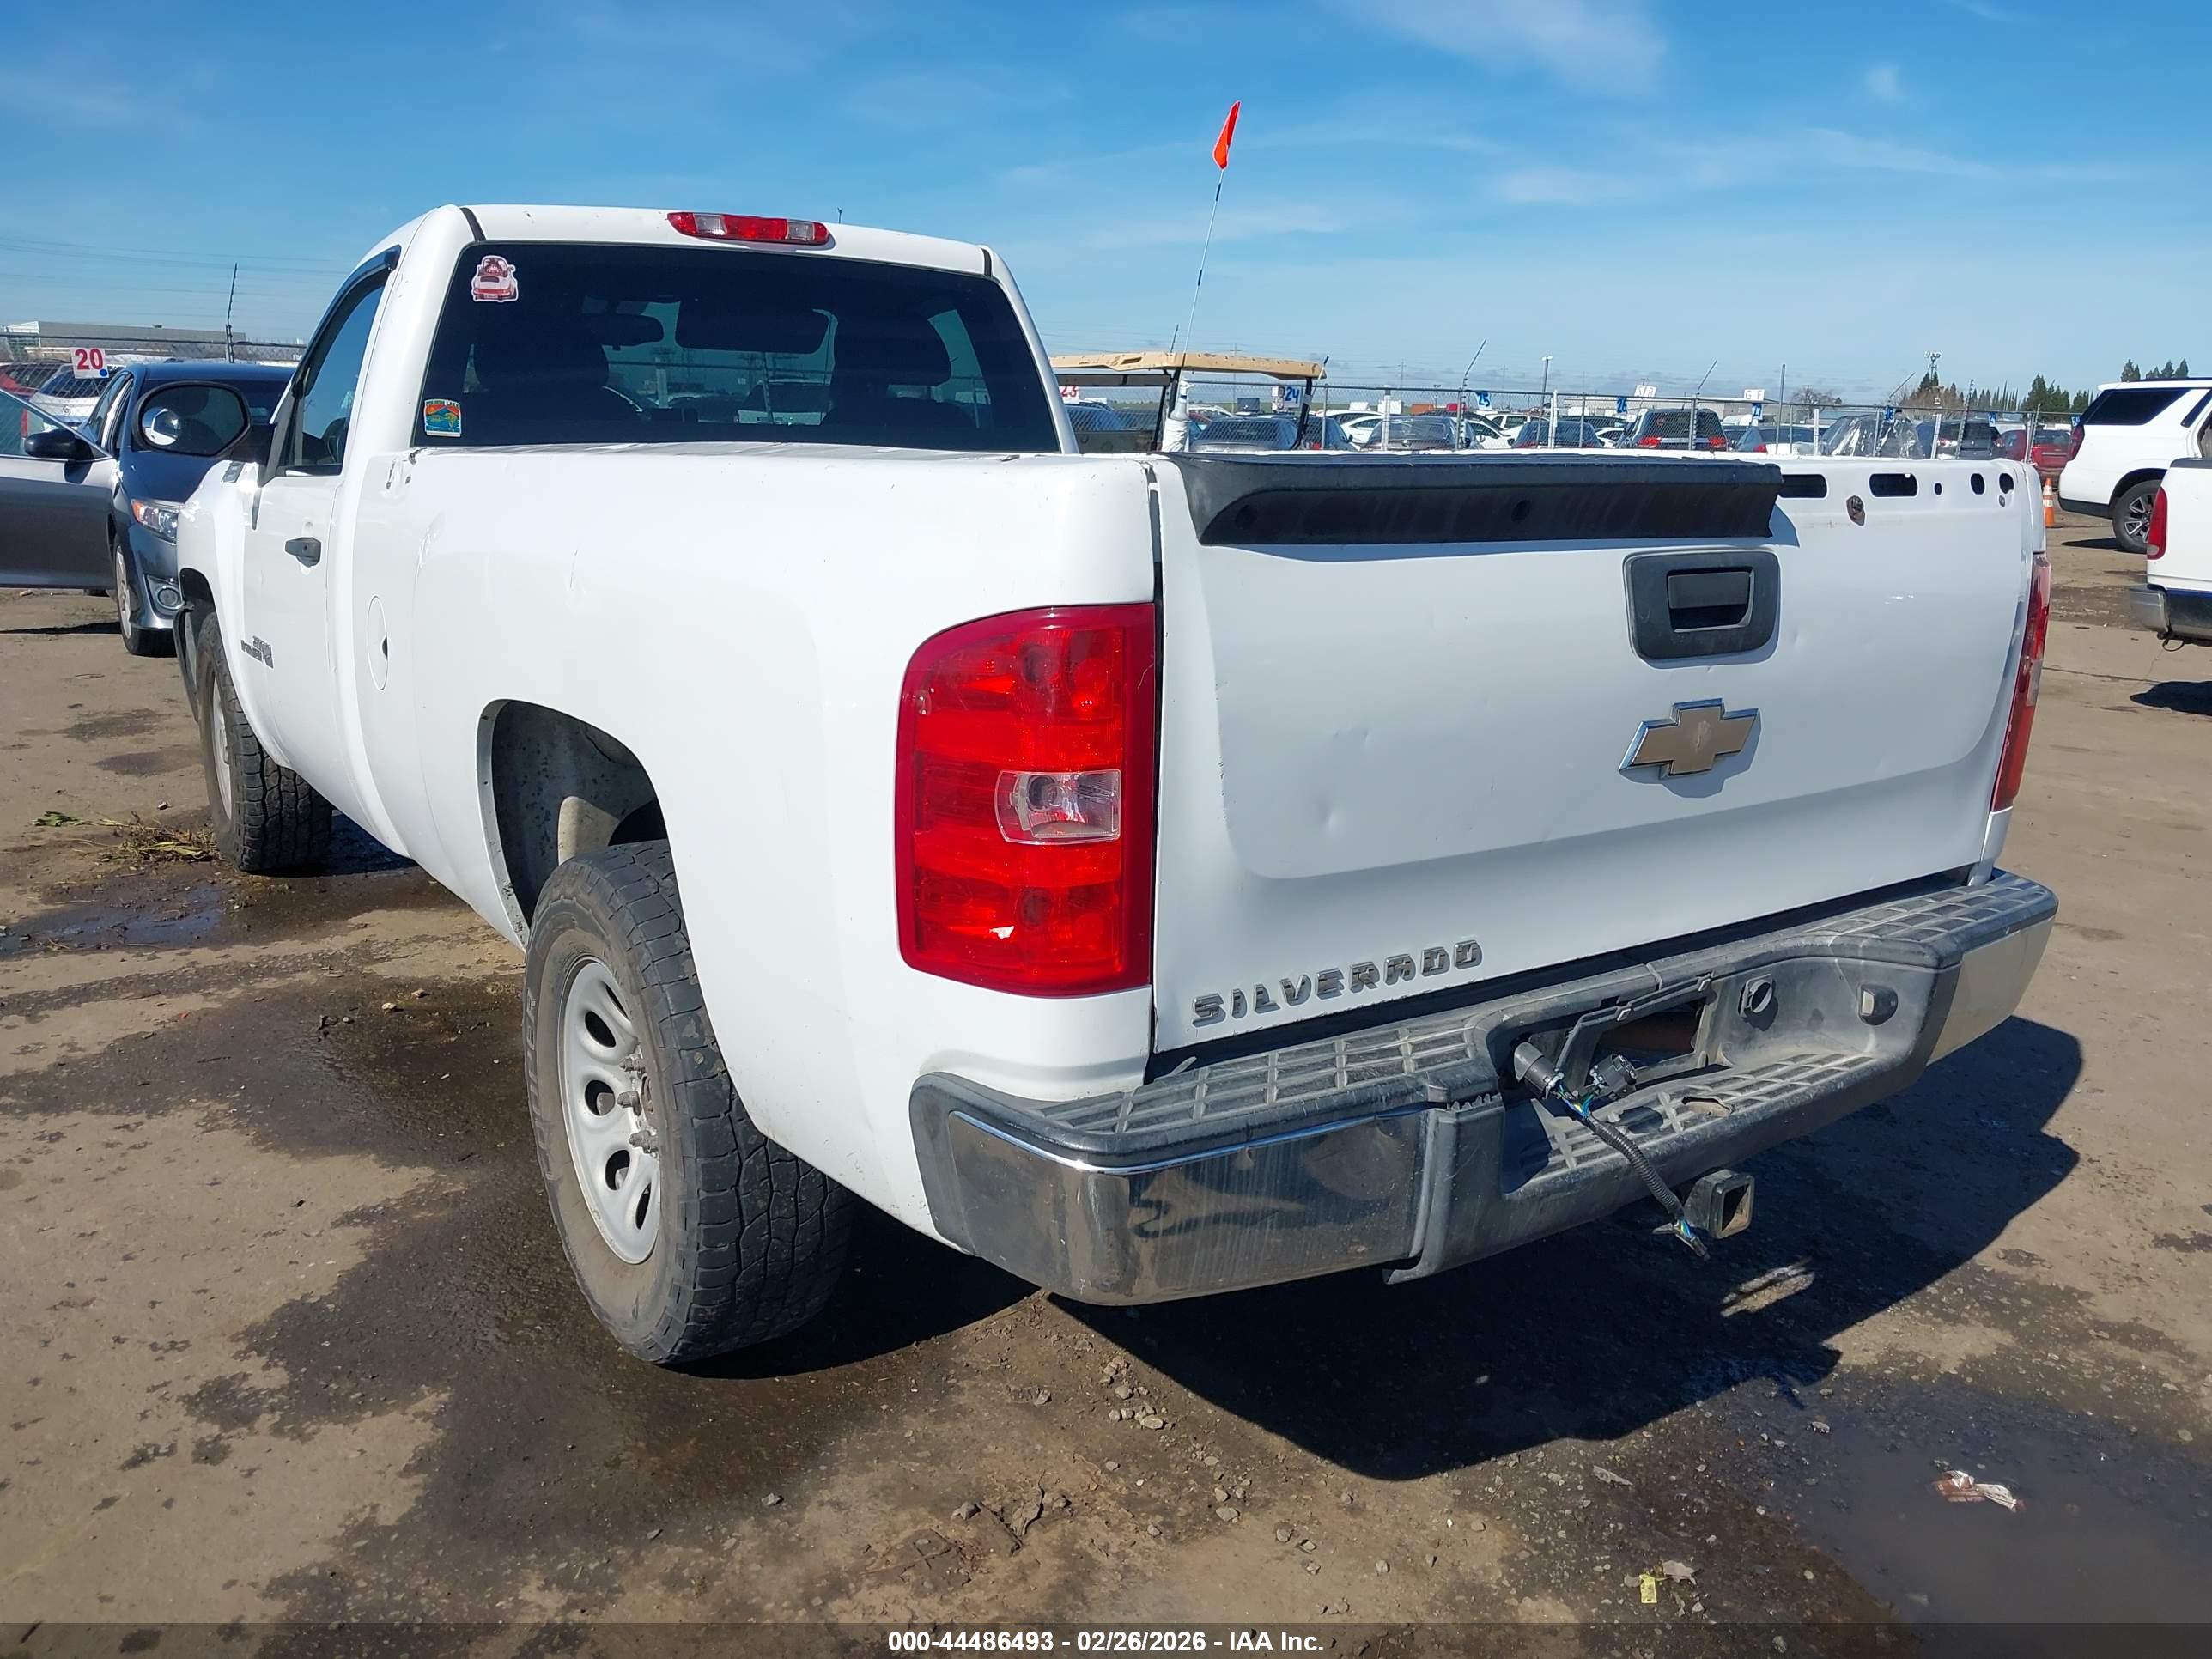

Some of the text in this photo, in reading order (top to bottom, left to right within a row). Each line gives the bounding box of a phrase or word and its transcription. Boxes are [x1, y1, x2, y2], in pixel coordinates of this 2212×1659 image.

[75, 348, 104, 370] 20
[1285, 386, 1300, 404] 24
[1477, 390, 1491, 407] 25
[1191, 939, 1483, 1028] SILVERADO
